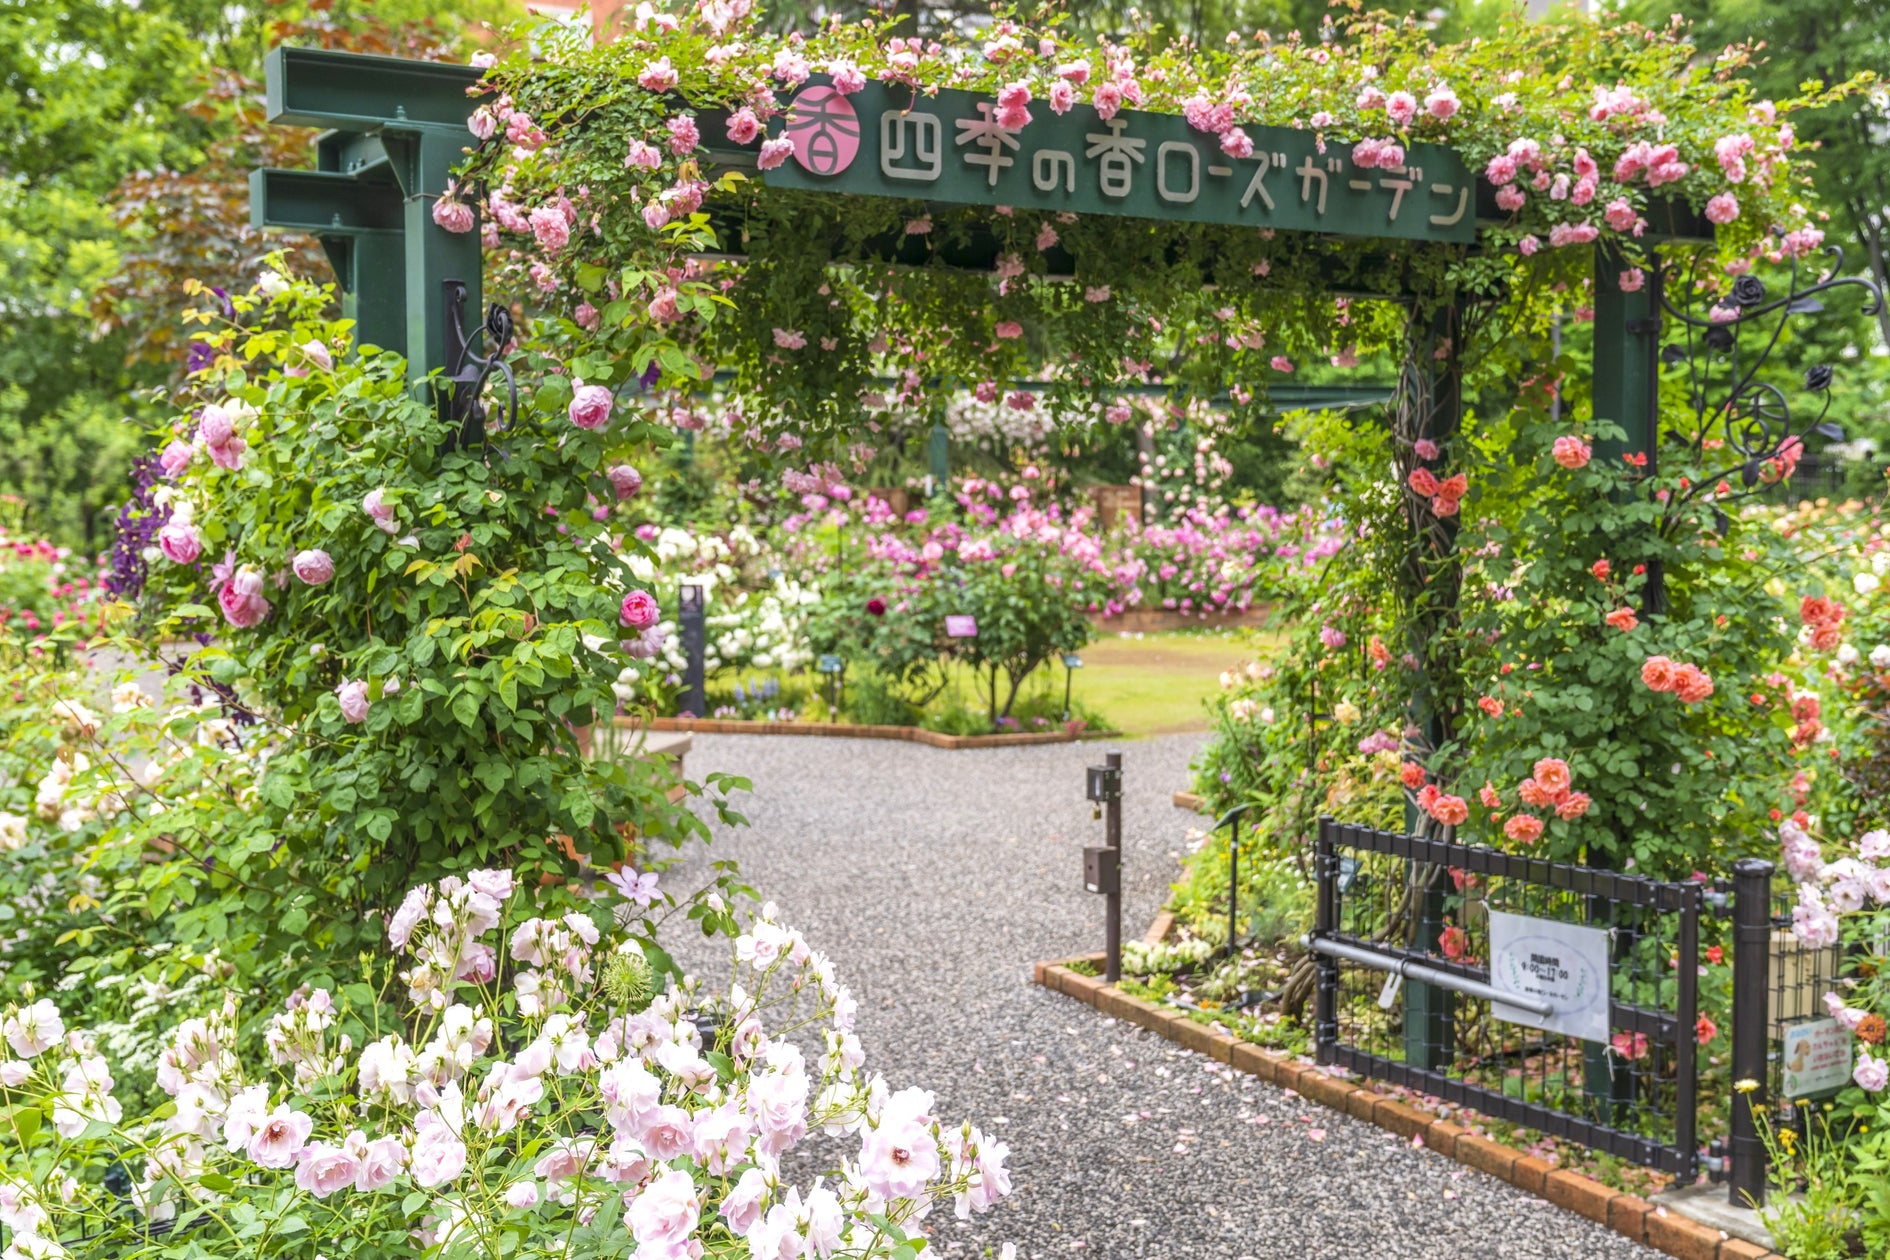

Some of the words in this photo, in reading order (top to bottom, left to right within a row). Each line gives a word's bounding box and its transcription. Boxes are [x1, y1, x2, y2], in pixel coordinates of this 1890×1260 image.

[880, 101, 1469, 226] 四季の香ローズガーデン
